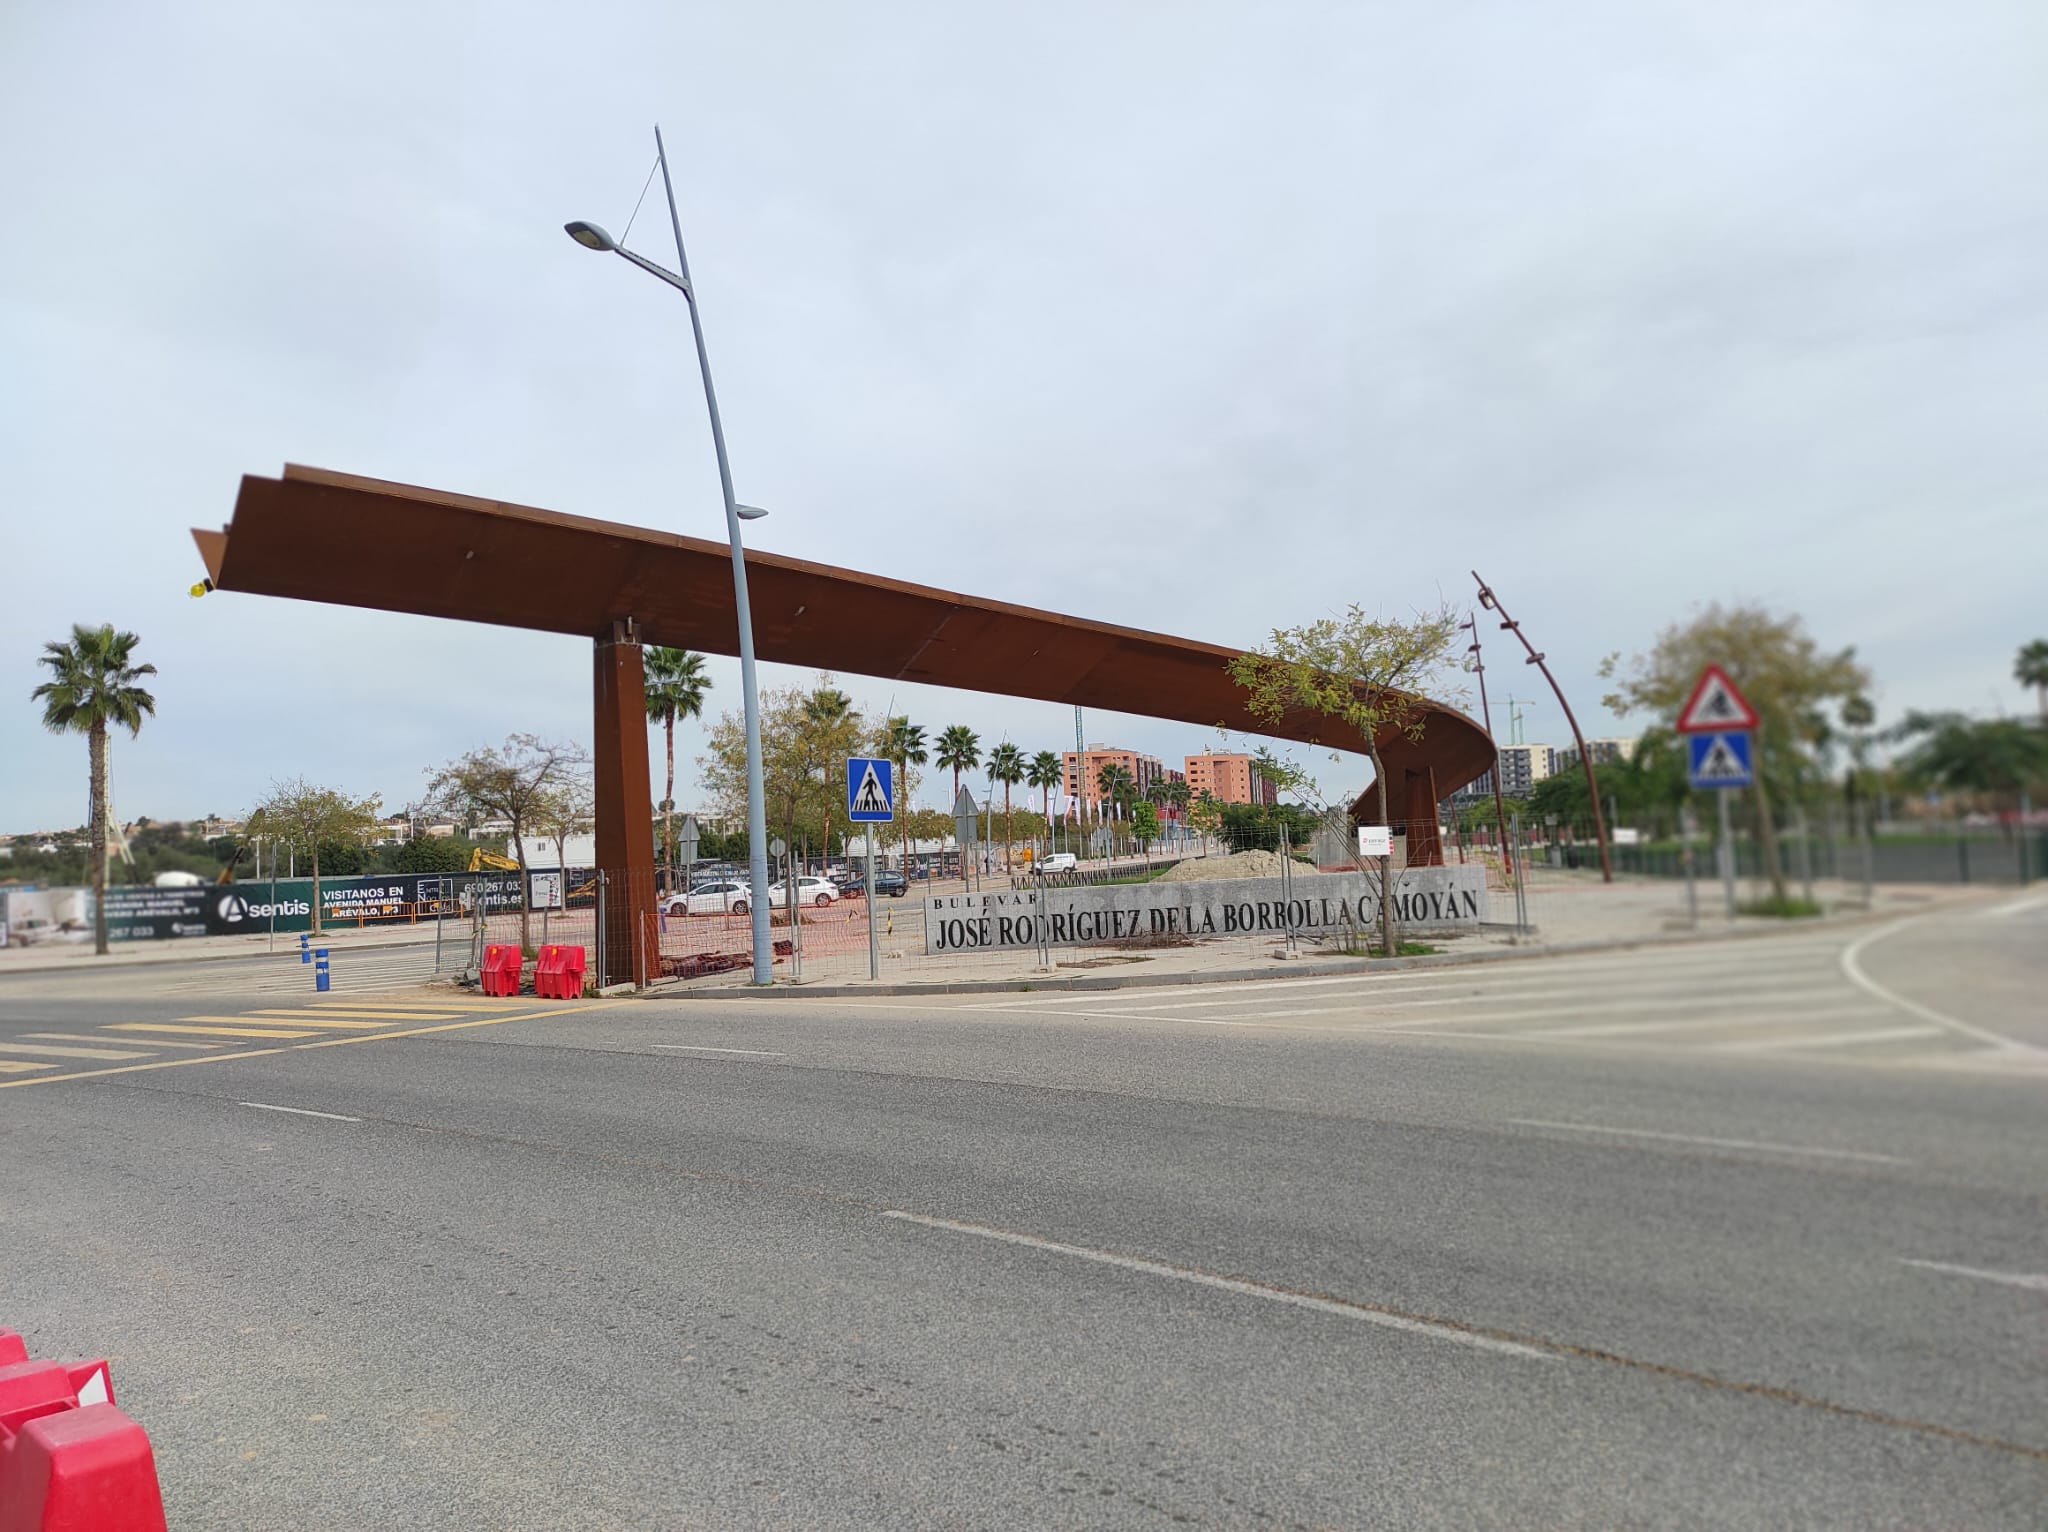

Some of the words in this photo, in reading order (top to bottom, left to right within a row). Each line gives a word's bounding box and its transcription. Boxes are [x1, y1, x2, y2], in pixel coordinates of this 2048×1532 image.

[323, 888, 384, 900] VISITANOS
[389, 886, 404, 896] EN
[324, 900, 365, 909] AVENIDA
[366, 897, 403, 906] MANUEL
[934, 894, 1037, 909] BULEVAR
[936, 908, 993, 950] JOSÉ
[998, 903, 1142, 945] RODRÍGUEZ
[1184, 904, 1217, 934] LA
